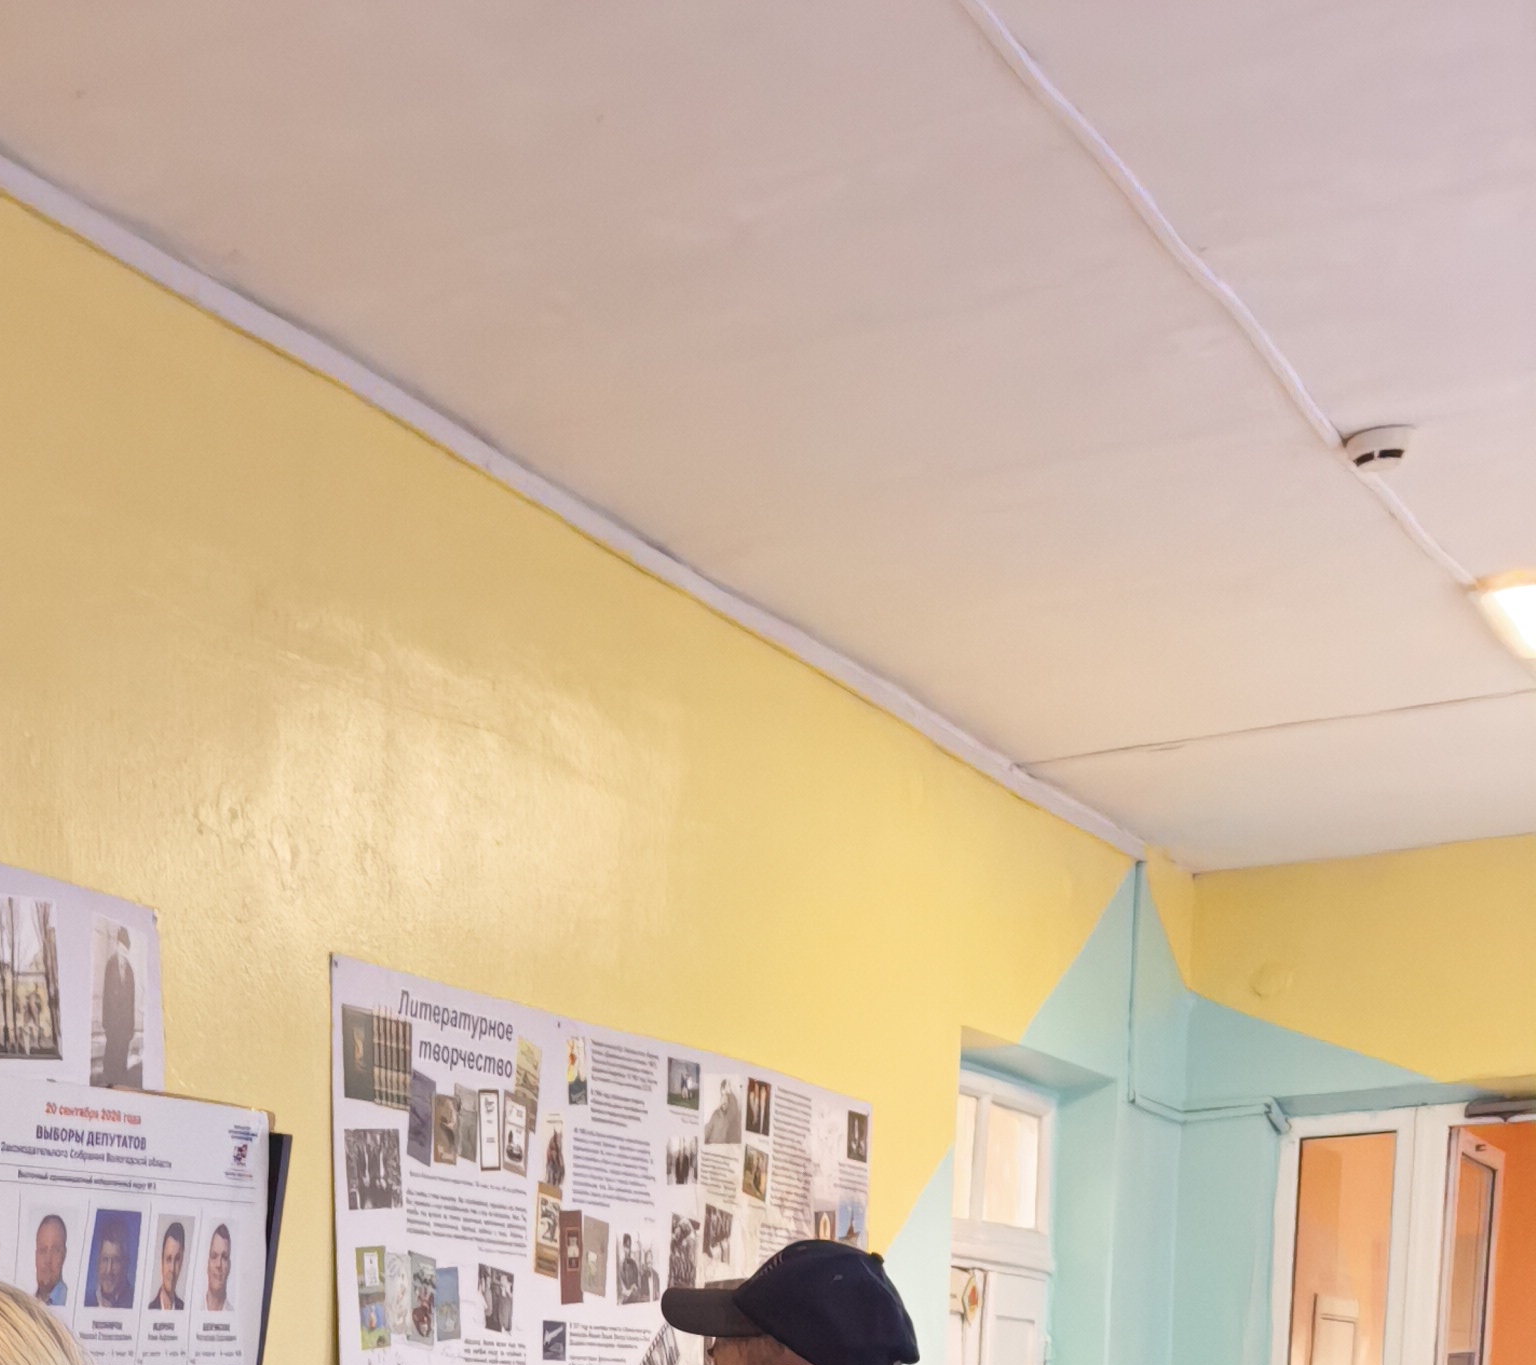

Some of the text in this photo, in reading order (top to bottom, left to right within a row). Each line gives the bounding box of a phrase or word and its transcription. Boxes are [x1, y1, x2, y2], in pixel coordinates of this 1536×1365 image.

[398, 989, 513, 1042] Литературное
[419, 1040, 513, 1079] творчество
[36, 1124, 147, 1151] ВЫБОРЫ ДЕПУТАТОВ
